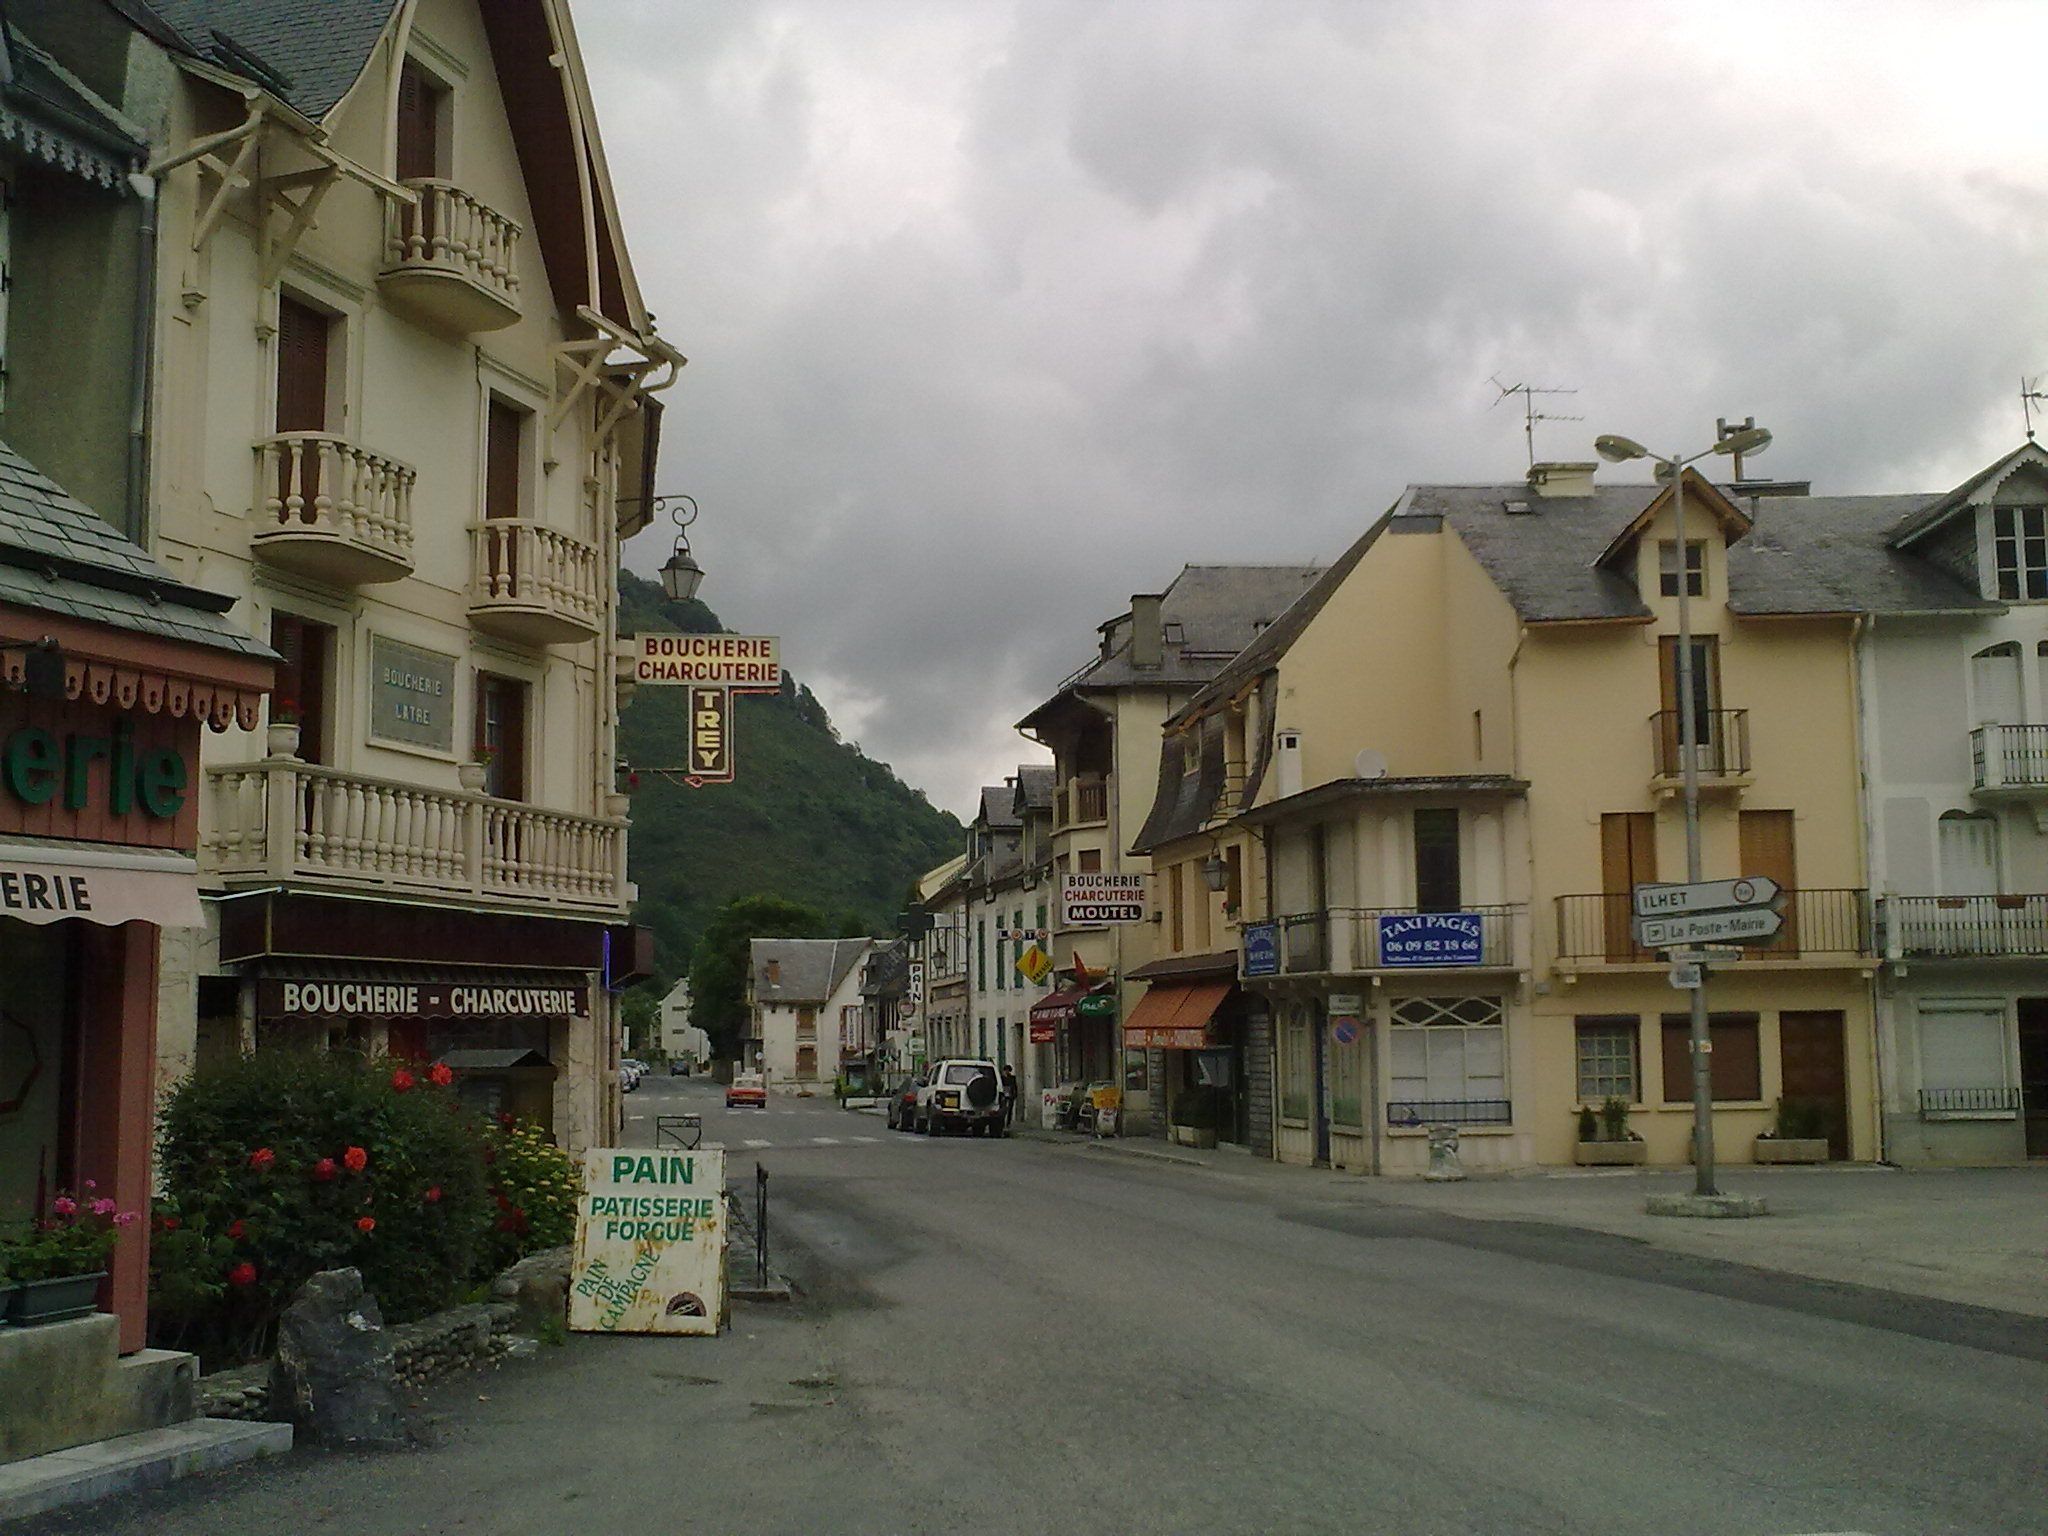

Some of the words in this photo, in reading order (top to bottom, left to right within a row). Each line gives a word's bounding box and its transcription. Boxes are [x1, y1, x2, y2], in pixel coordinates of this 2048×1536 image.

[645, 637, 771, 658] BOUCHERIE
[383, 667, 442, 696] BOUCHERIE
[638, 661, 778, 681] CHARCUTERIE
[696, 690, 721, 768] TREY
[2, 716, 188, 819] erie
[1068, 875, 1141, 887] BOUCHERIE
[1064, 889, 1145, 902] CHARCUTERIE
[1071, 906, 1139, 919] MOUTEL
[1381, 917, 1421, 938] TAXI
[1671, 924, 1684, 938] La
[1386, 941, 1403, 952] 06
[1405, 940, 1421, 952] 09
[1423, 940, 1440, 951] 82
[1461, 940, 1479, 950] 66
[912, 965, 921, 1001] PAIN
[284, 982, 419, 1013] BOUCHERIE
[450, 987, 577, 1015] CHARCUTERIE
[612, 1155, 694, 1185] PAIN
[590, 1196, 714, 1219] PATISSERIE
[605, 1220, 694, 1241] FORGUE
[576, 1258, 609, 1297] PAIN
[596, 1275, 620, 1300] DE
[600, 1250, 660, 1330] CAMPAGNE
